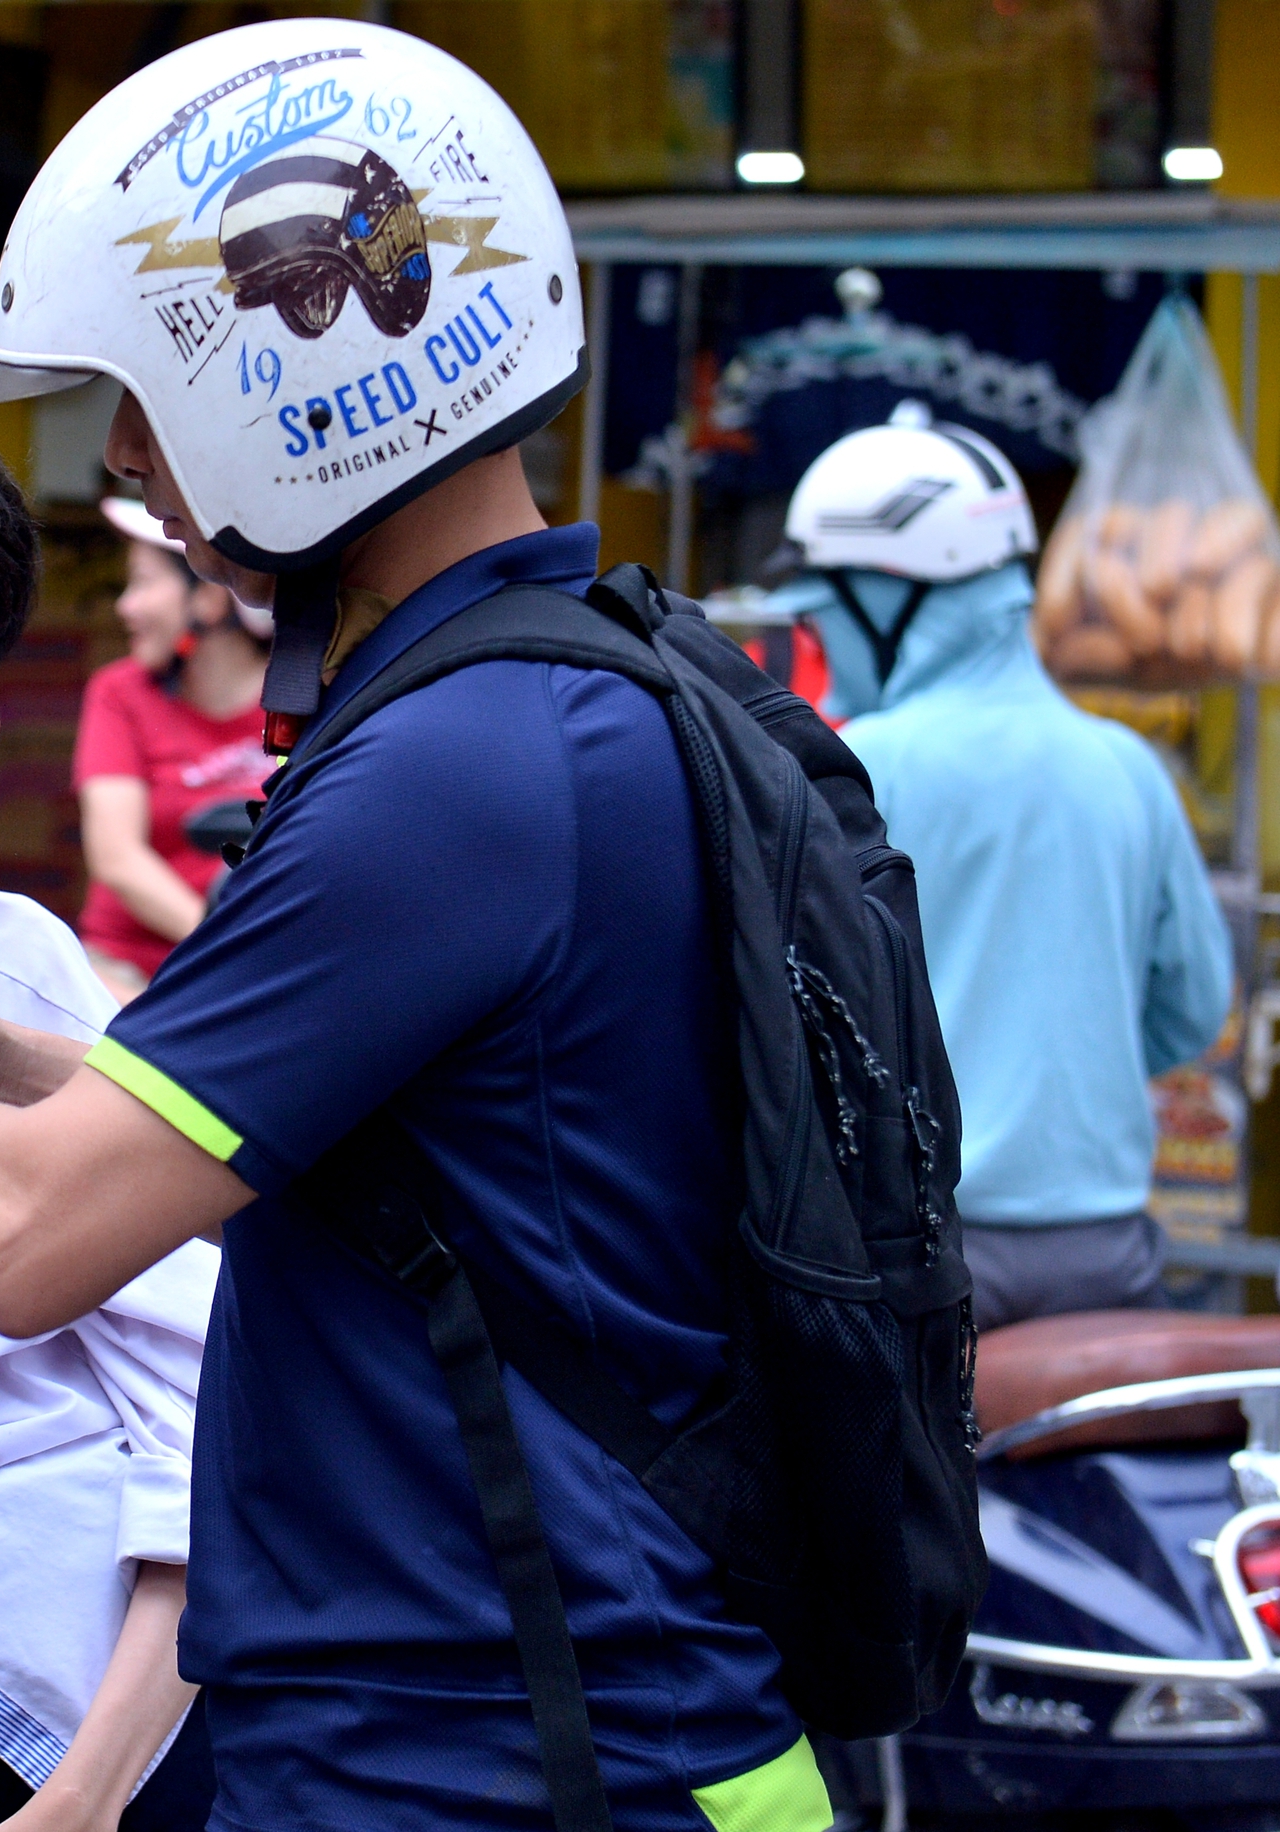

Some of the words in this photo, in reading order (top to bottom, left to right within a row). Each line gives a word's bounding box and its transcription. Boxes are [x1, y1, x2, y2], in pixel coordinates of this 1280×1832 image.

[184, 65, 268, 116] ORIGINAL
[364, 91, 417, 143] 62
[166, 72, 354, 190] Custom
[429, 129, 490, 184] FIRE
[154, 294, 225, 365] HELL
[235, 339, 283, 403] 19
[277, 360, 419, 458] SPEED
[422, 280, 515, 387] CULT
[317, 434, 412, 484] ORIGINAL
[450, 351, 520, 421] GENUINE
